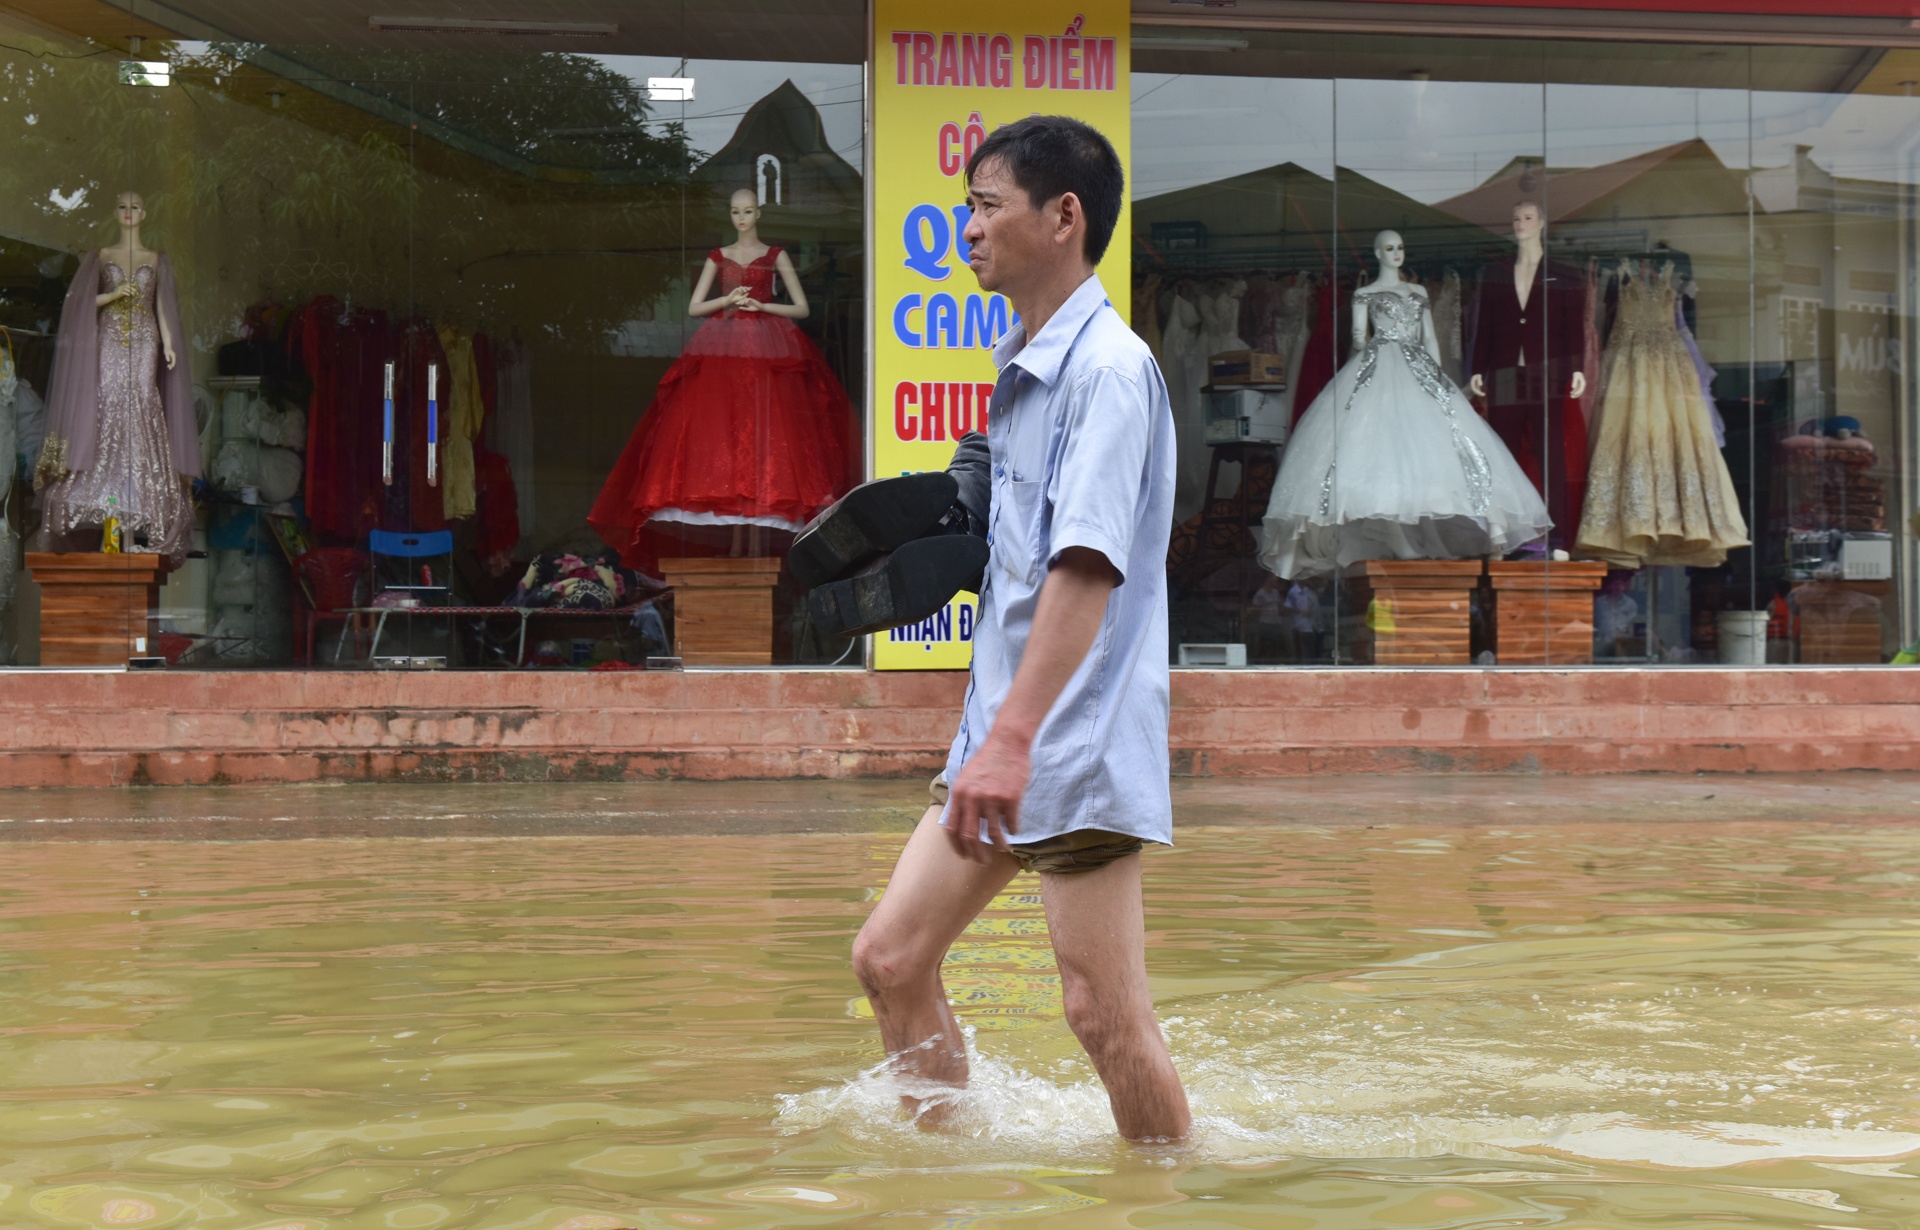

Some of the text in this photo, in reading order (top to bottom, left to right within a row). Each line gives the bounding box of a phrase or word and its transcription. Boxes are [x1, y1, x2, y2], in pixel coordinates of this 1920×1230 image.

[891, 14, 1117, 91] TRANG ĐIỂM
[892, 292, 1021, 351] CAM
